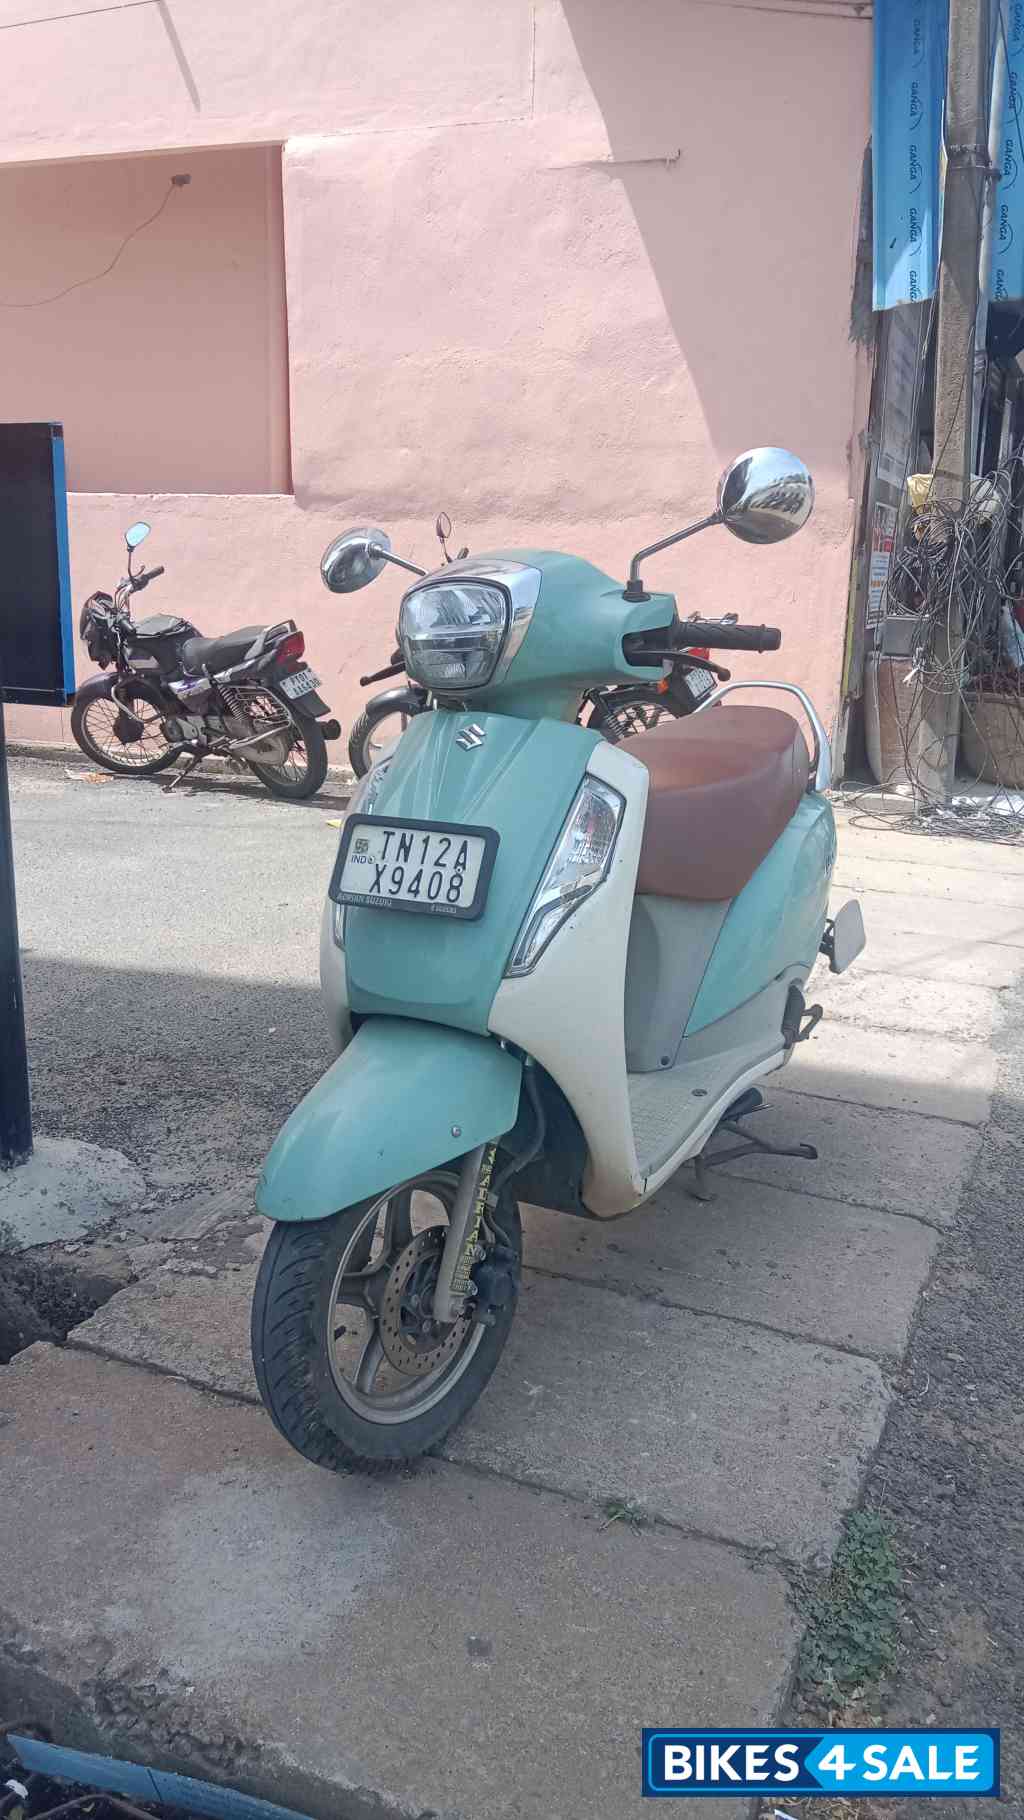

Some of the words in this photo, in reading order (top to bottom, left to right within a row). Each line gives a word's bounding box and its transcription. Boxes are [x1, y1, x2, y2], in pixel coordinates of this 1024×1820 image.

[912, 18, 921, 55] GANGA
[911, 81, 919, 117] GANGA
[1003, 139, 1014, 176] GANGA
[999, 205, 1008, 241] GANGA
[351, 855, 366, 864] IND
[381, 830, 469, 871] TN12A
[369, 863, 464, 903] X9408
